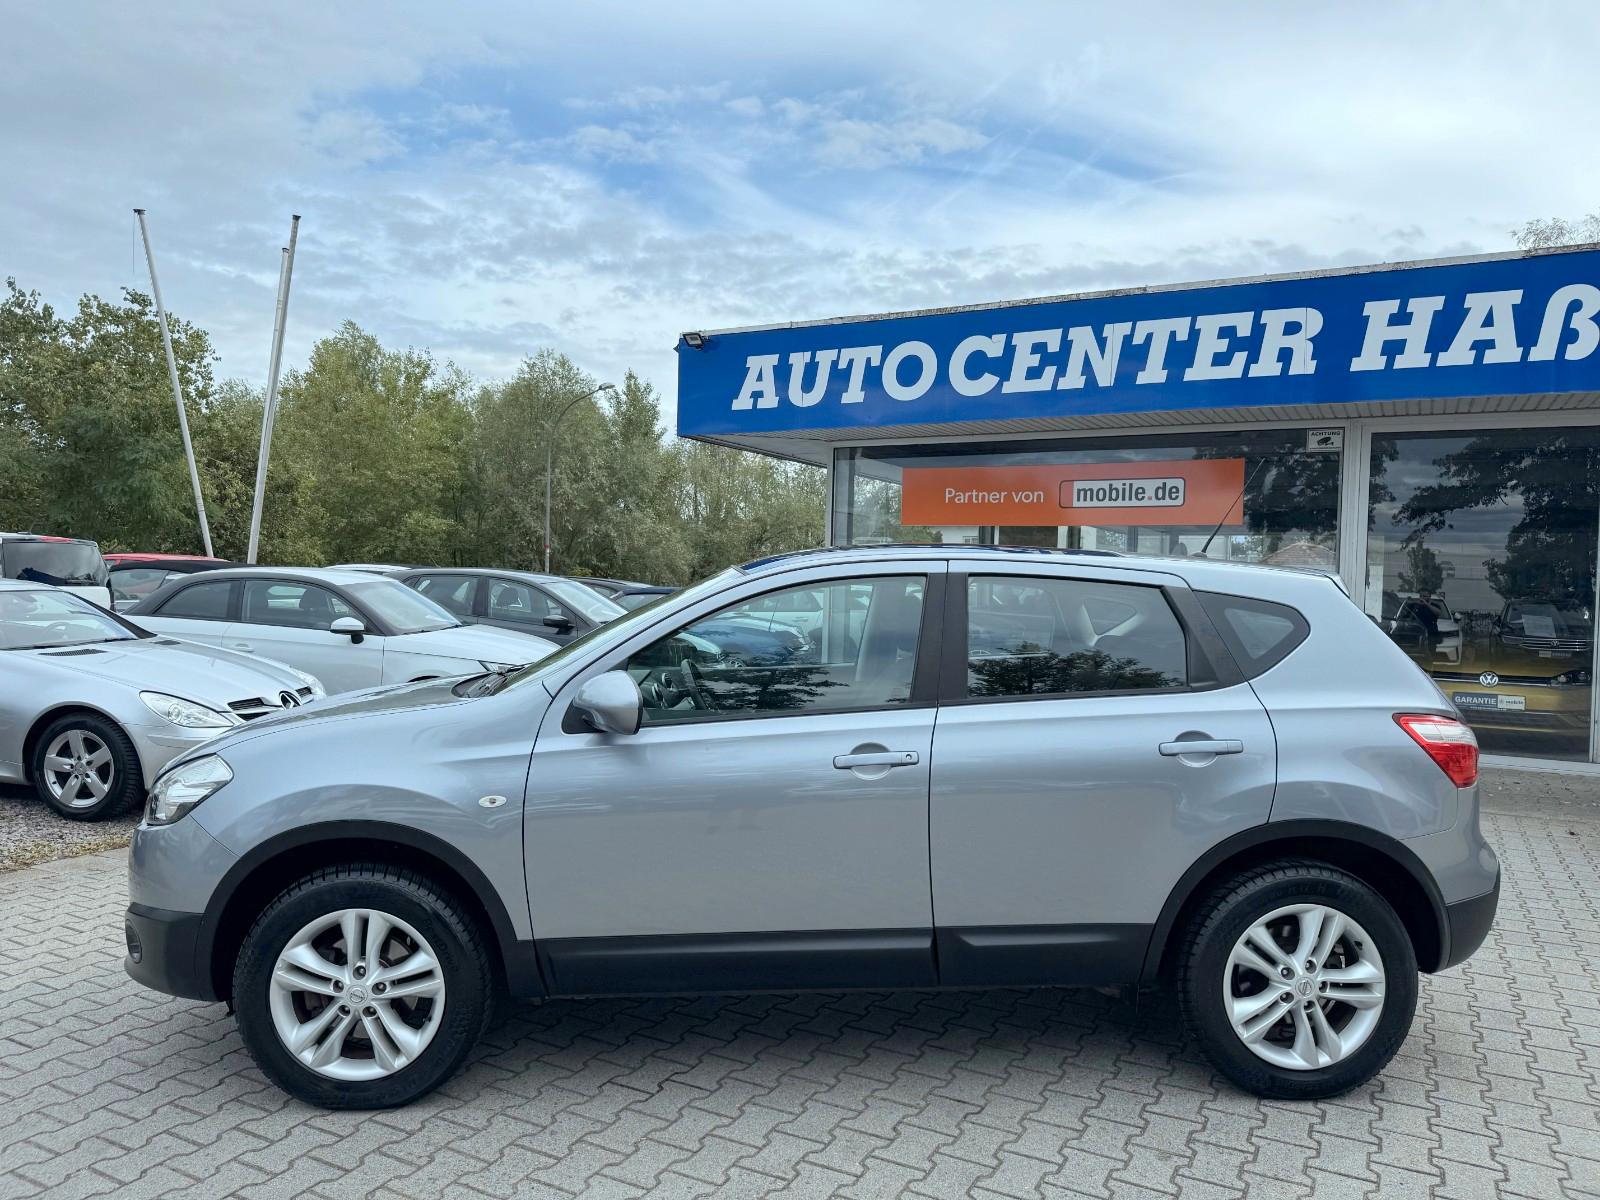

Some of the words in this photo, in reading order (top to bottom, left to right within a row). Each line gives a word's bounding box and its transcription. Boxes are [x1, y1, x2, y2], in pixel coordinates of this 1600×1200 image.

[731, 340, 938, 411] AUTO
[948, 307, 1324, 397] CENTER
[1349, 283, 1600, 372] HAß
[944, 487, 1007, 504] Partner
[1011, 490, 1045, 504] von
[1076, 481, 1181, 503] mobile.de
[1454, 695, 1497, 705] GARANTIE
